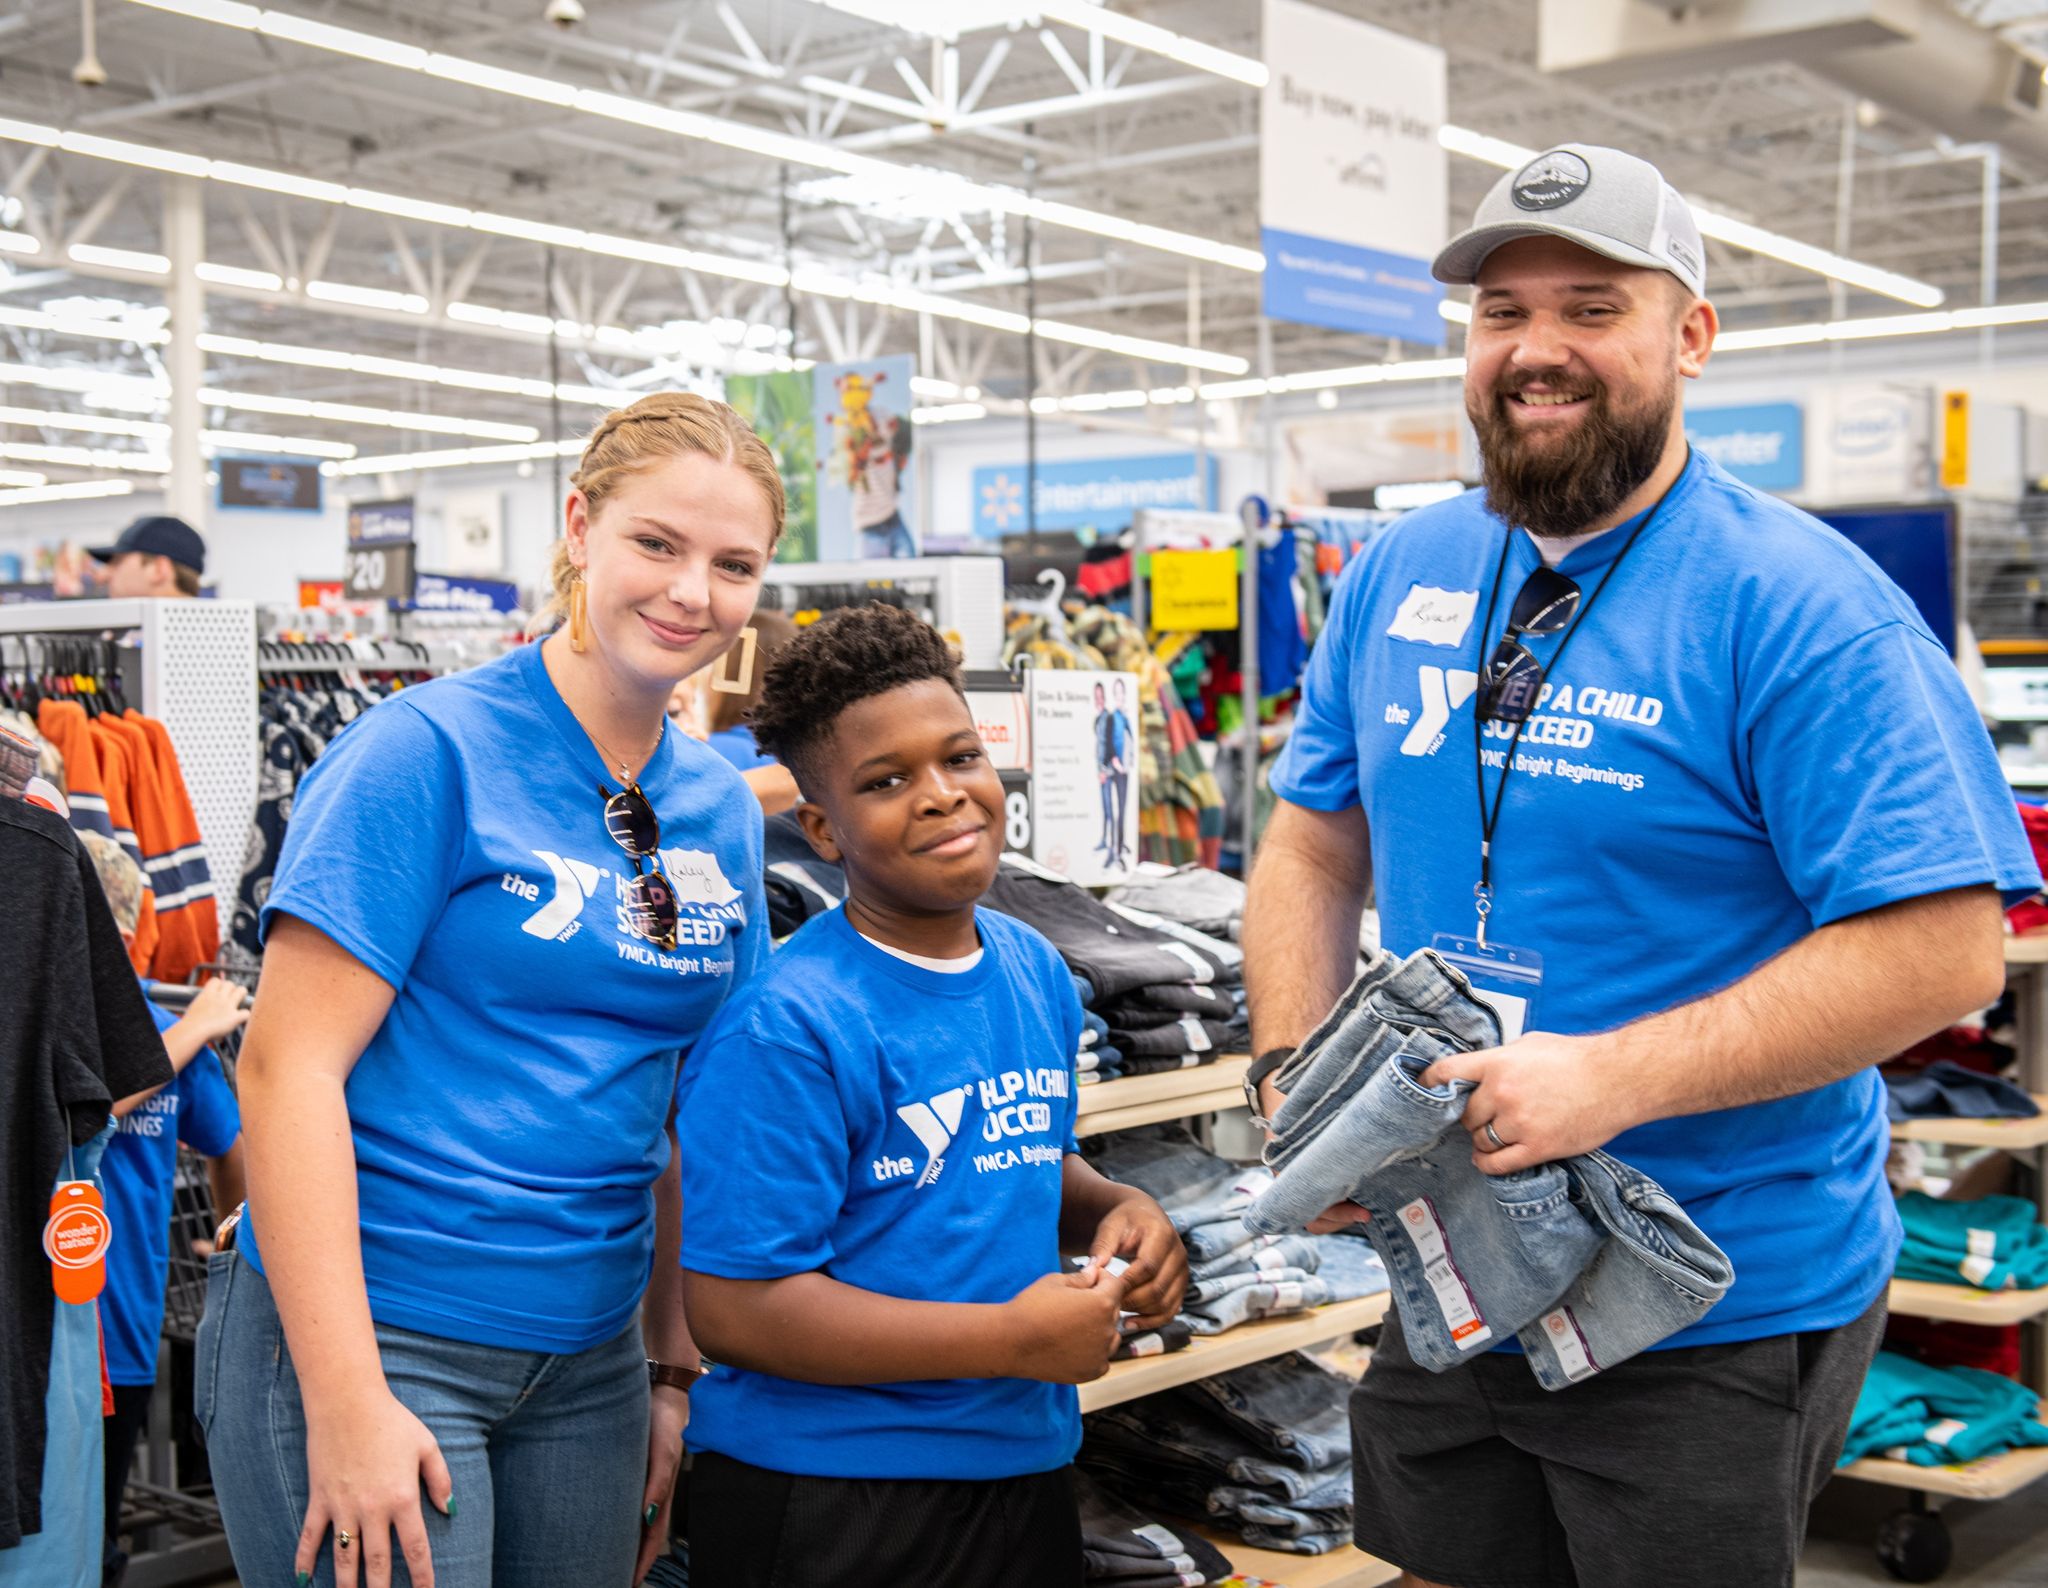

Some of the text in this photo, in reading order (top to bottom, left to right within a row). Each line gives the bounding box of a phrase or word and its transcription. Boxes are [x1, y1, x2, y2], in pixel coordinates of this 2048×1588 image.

[1384, 702, 1411, 726] the
[1549, 684, 1573, 713] A
[1576, 686, 1664, 727] CHILD
[1426, 733, 1447, 756] YMCA
[1515, 753, 1553, 778] Bright
[1555, 758, 1645, 791] Beginnings
[500, 872, 540, 902] the
[556, 919, 583, 944] YMCA
[616, 940, 658, 967] YMCA
[658, 953, 700, 976] Bright
[872, 1155, 915, 1181] the
[925, 1158, 946, 1185] YMCA
[972, 1148, 1022, 1174] YMCA
[56, 1222, 100, 1240] wonder
